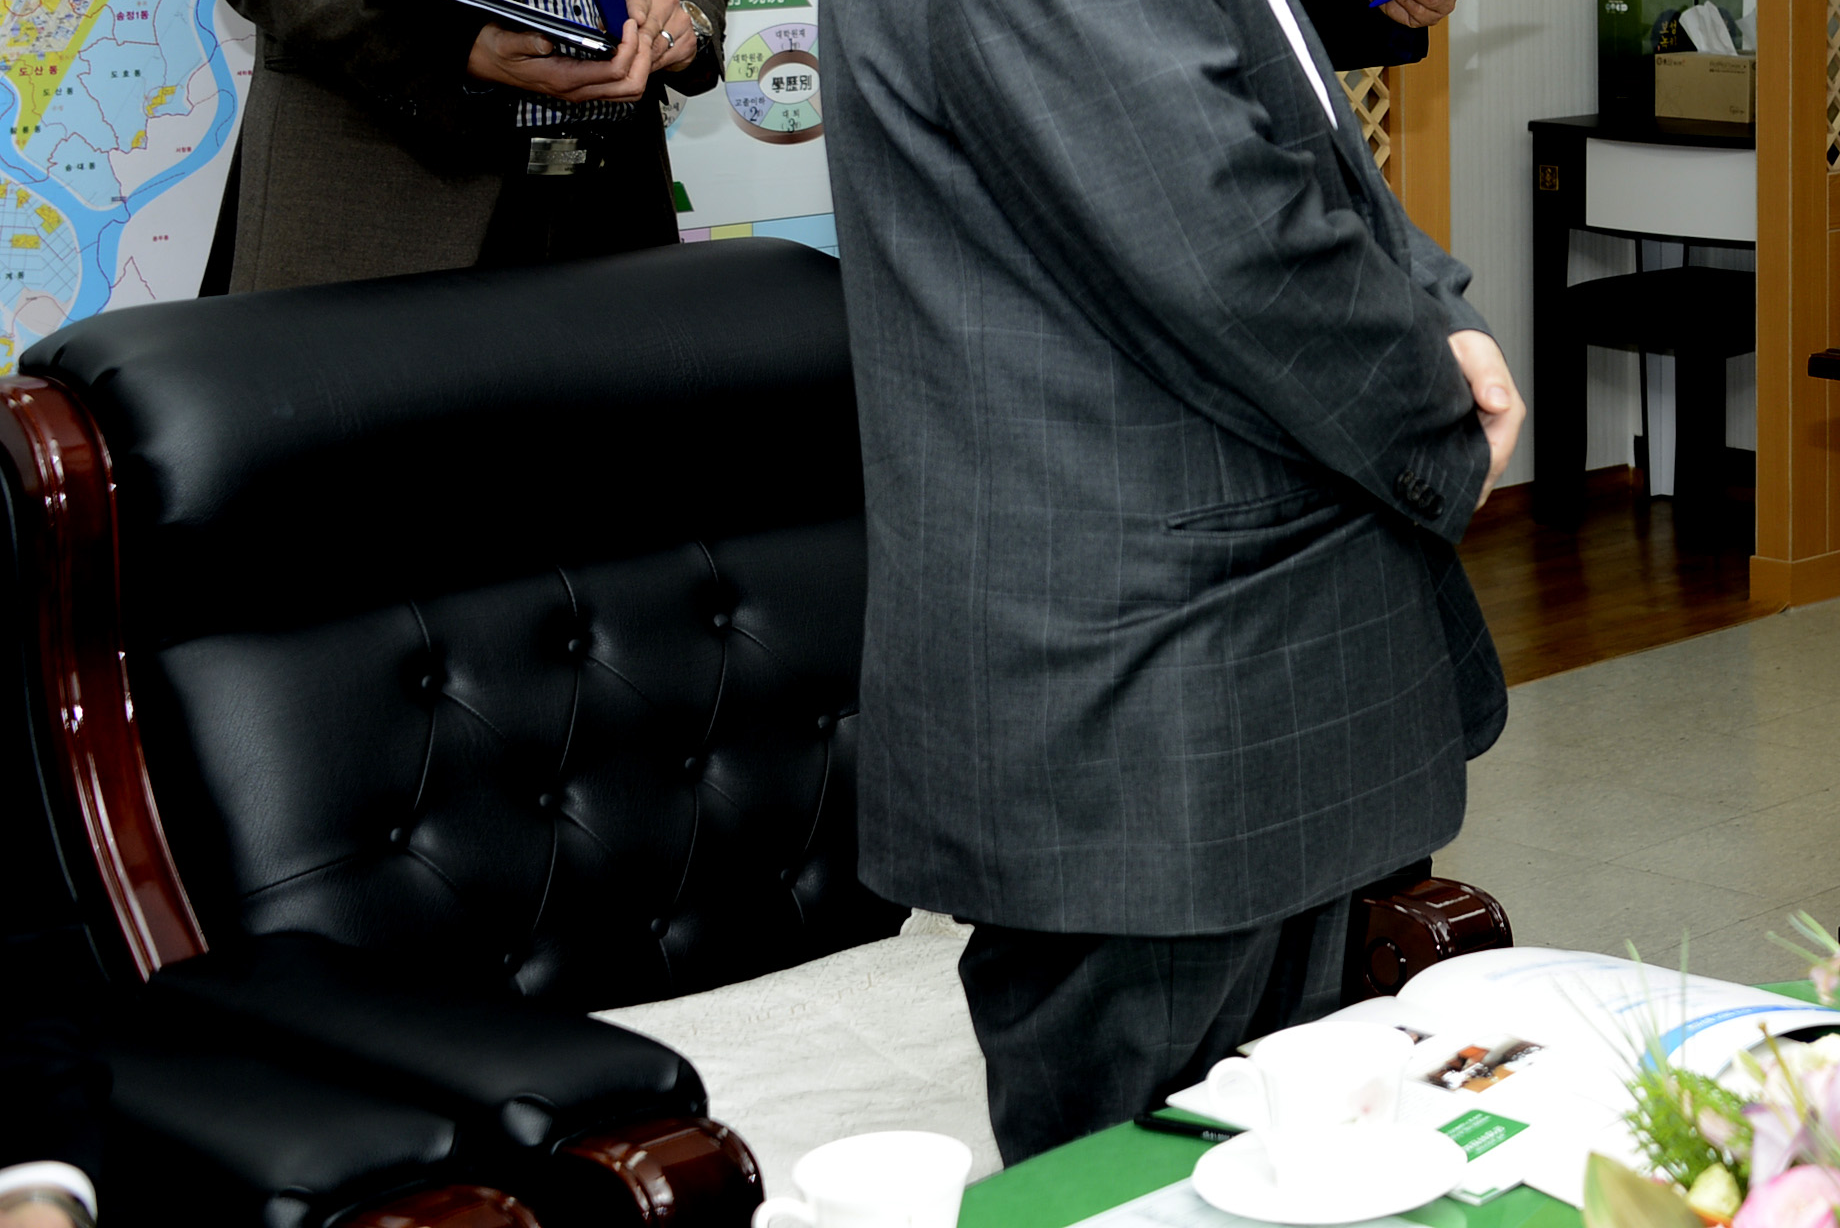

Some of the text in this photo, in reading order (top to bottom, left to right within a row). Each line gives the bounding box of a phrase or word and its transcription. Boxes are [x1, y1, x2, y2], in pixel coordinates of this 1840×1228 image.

[116, 10, 149, 21] 송정1동
[18, 65, 58, 76] 도산동
[43, 87, 73, 96] 도산동
